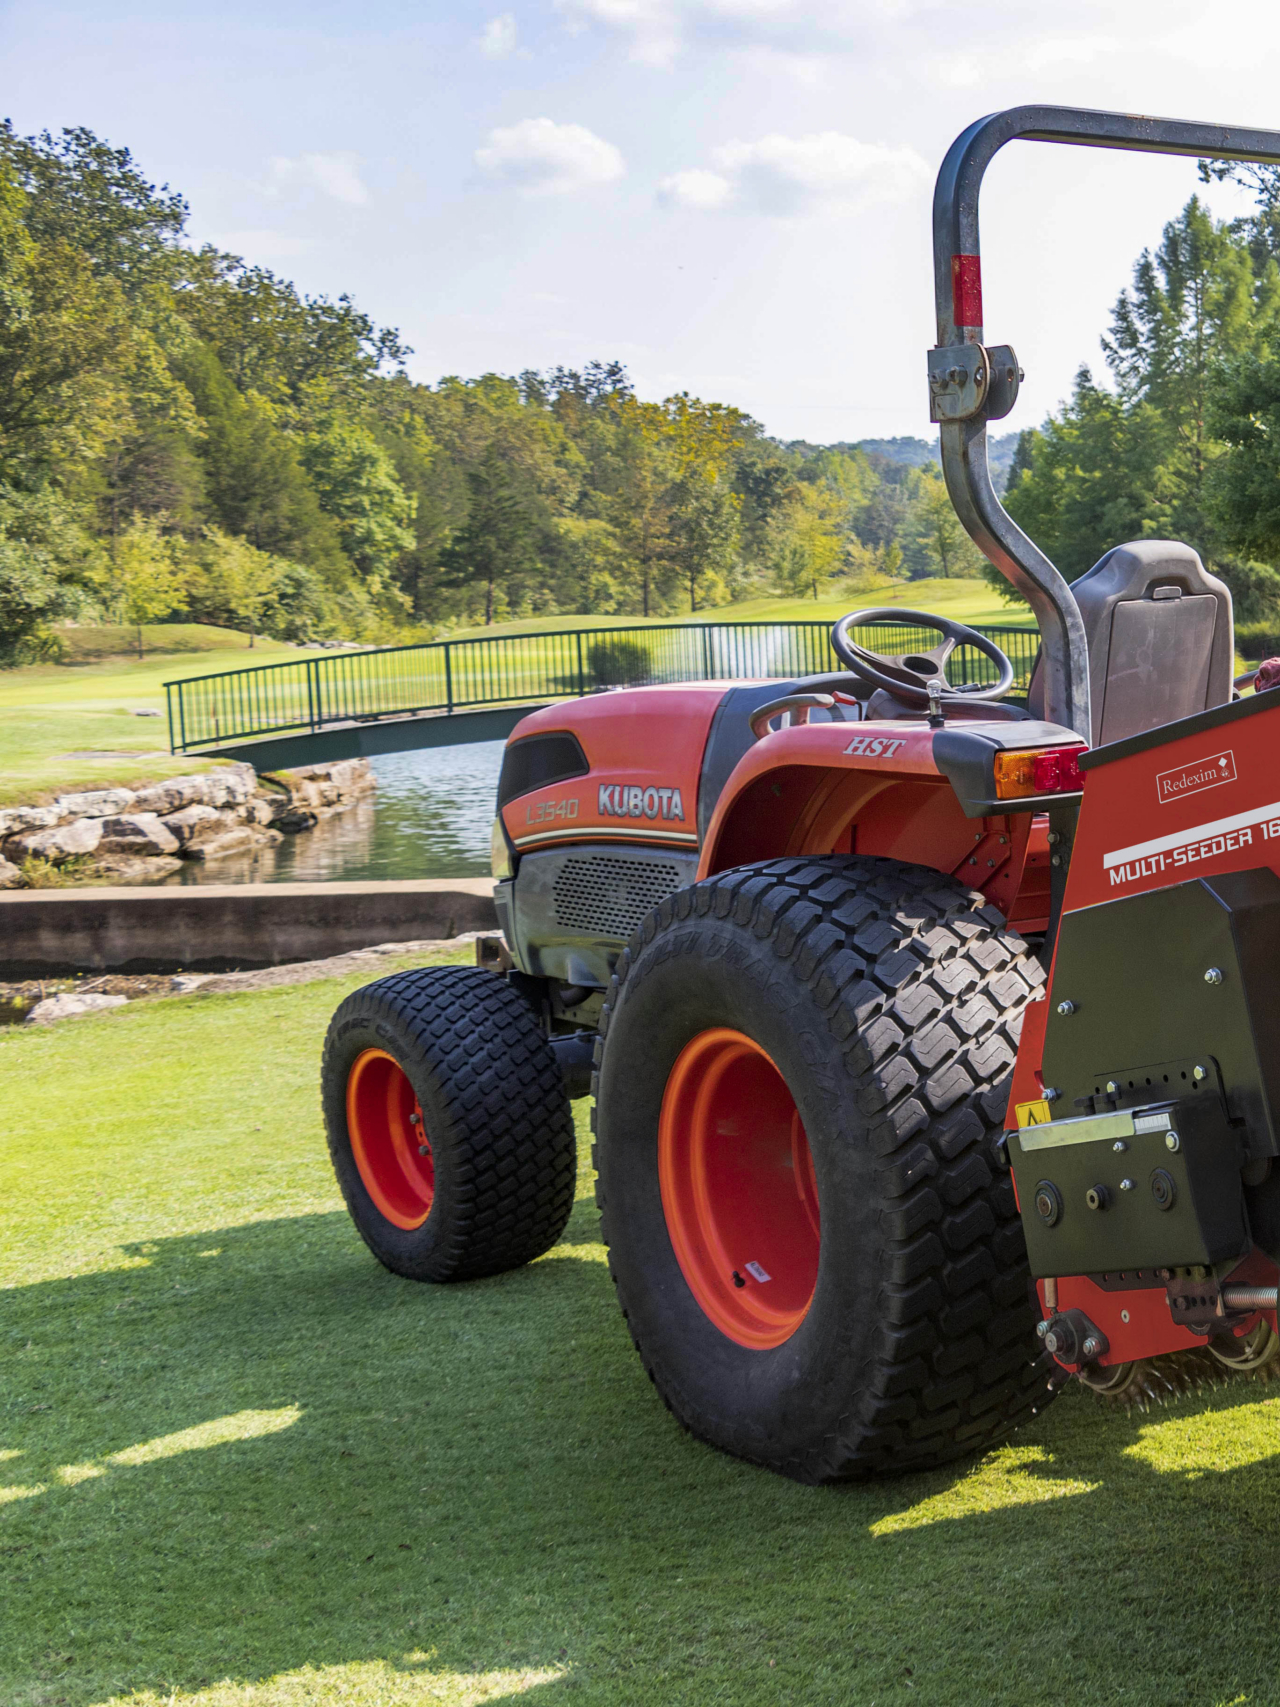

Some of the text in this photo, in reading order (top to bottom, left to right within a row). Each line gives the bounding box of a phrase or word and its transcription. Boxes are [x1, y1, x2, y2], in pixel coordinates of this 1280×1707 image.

[842, 736, 908, 758] HST
[1163, 769, 1217, 794] Redexim
[526, 799, 579, 825] L3540
[598, 784, 685, 821] KUBOTA
[1109, 829, 1252, 886] MULTI-SEEDER
